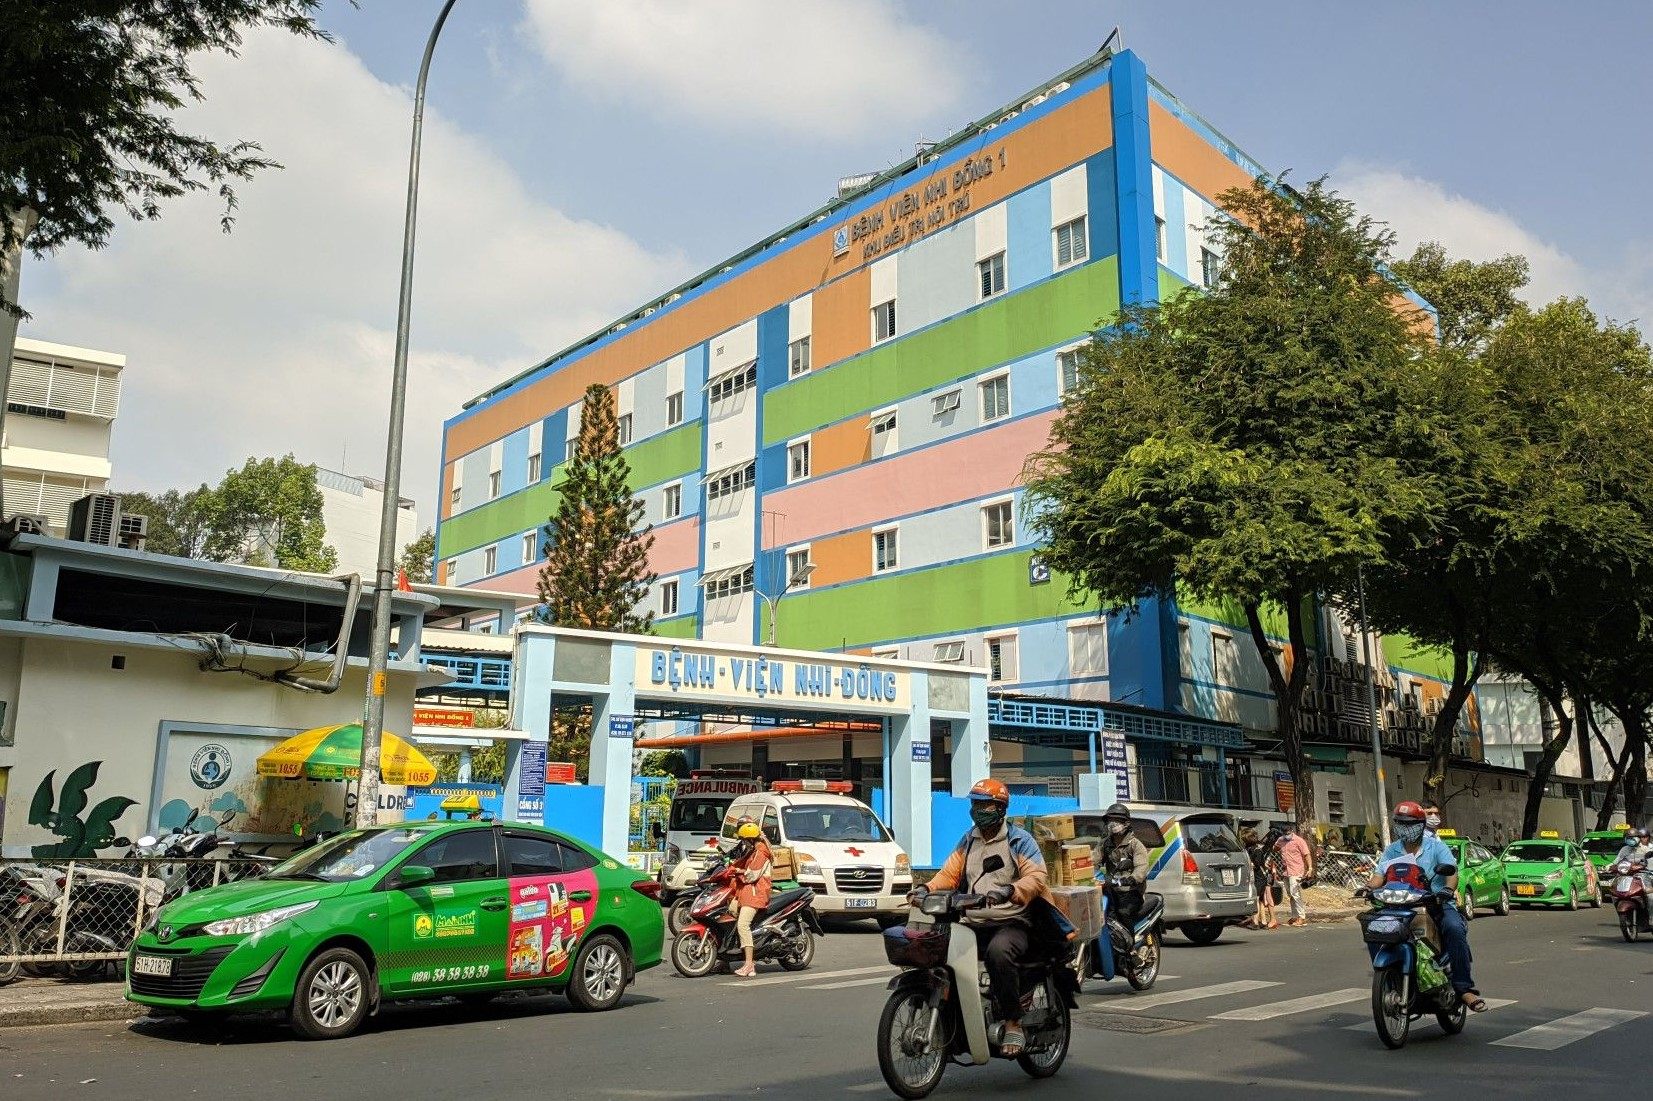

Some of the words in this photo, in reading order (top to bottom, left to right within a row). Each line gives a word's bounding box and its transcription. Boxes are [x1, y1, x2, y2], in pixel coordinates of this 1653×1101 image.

[851, 209, 884, 243] BỆNH
[890, 192, 919, 221] VIỆN
[924, 177, 947, 206] NHI
[953, 155, 992, 190] ĐỒNG
[999, 146, 1006, 167] 1
[280, 763, 298, 774] 1055
[408, 772, 430, 782] 1055
[432, 968, 446, 982] 38
[447, 967, 460, 981] 38
[462, 966, 475, 980] 38
[476, 965, 490, 979] 38
